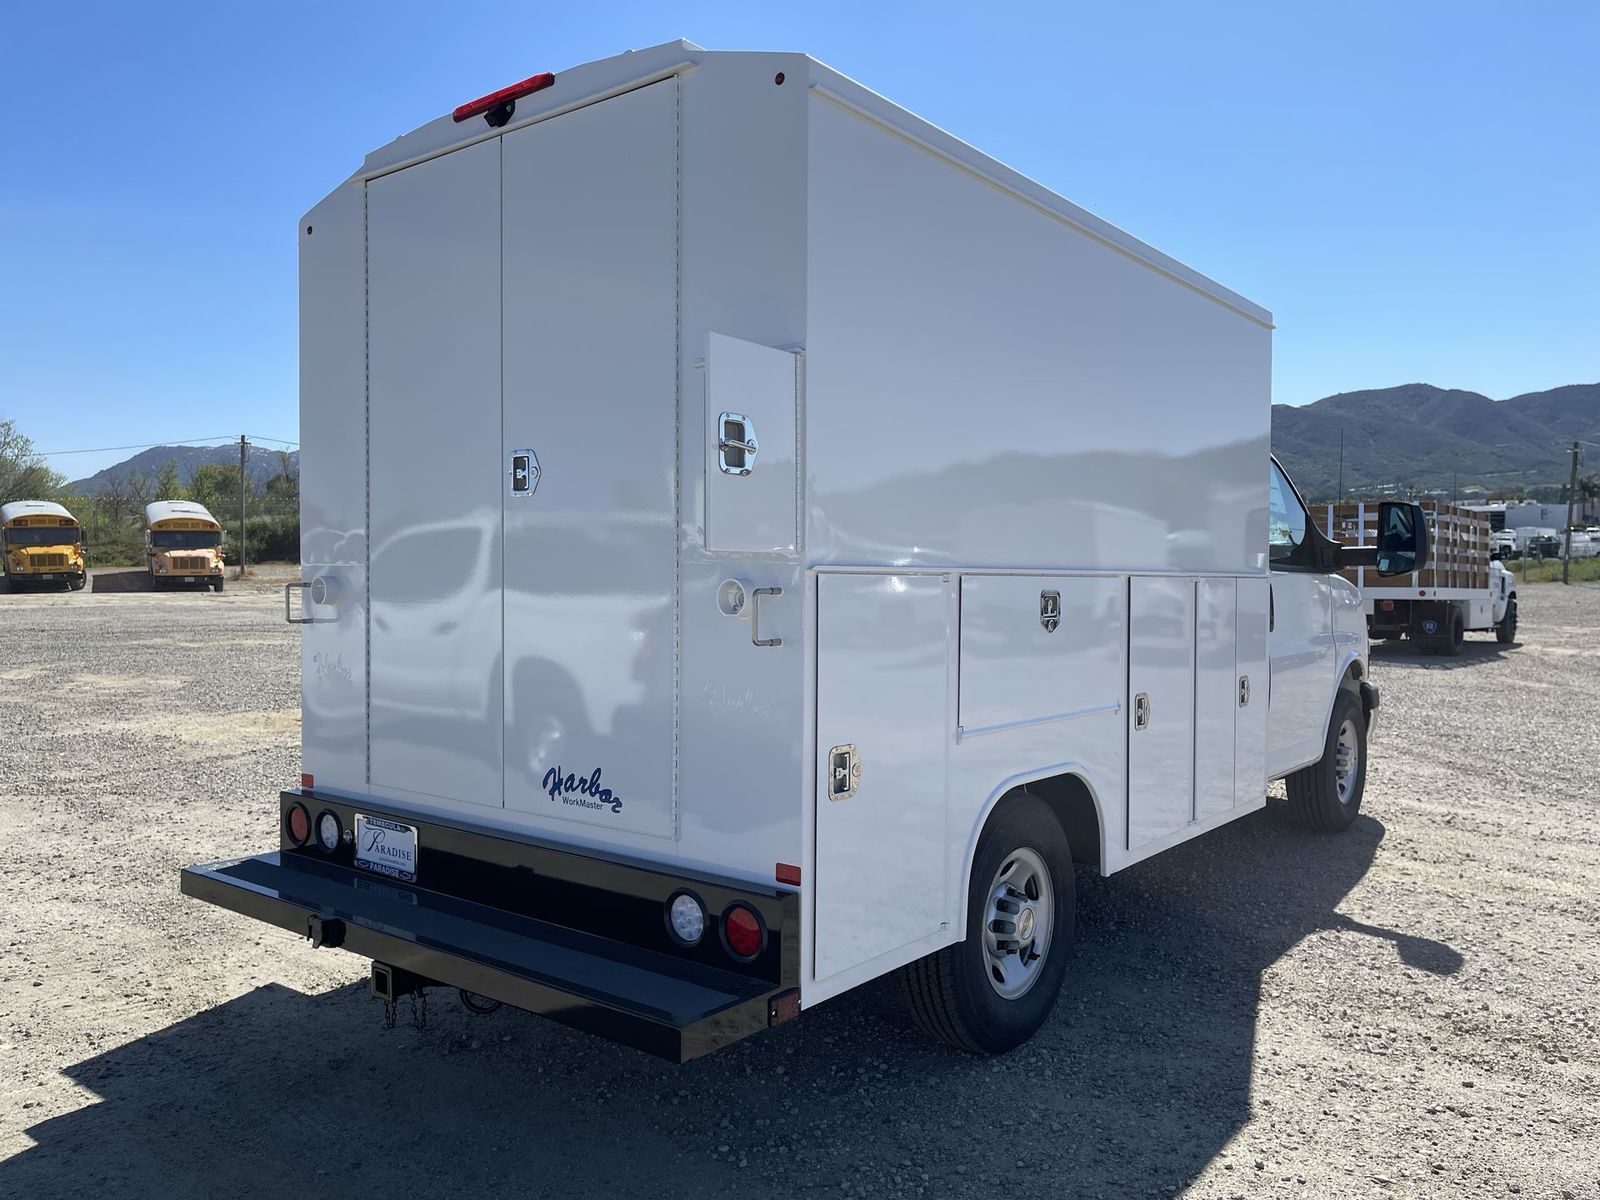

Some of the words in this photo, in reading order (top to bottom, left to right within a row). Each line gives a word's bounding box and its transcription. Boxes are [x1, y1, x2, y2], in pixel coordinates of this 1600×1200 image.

[542, 766, 622, 813] Harbor
[562, 796, 603, 810] WorkMaster
[370, 819, 401, 832] TEMECULA
[362, 824, 411, 861] PARADISE
[370, 862, 399, 876] PARADISE
